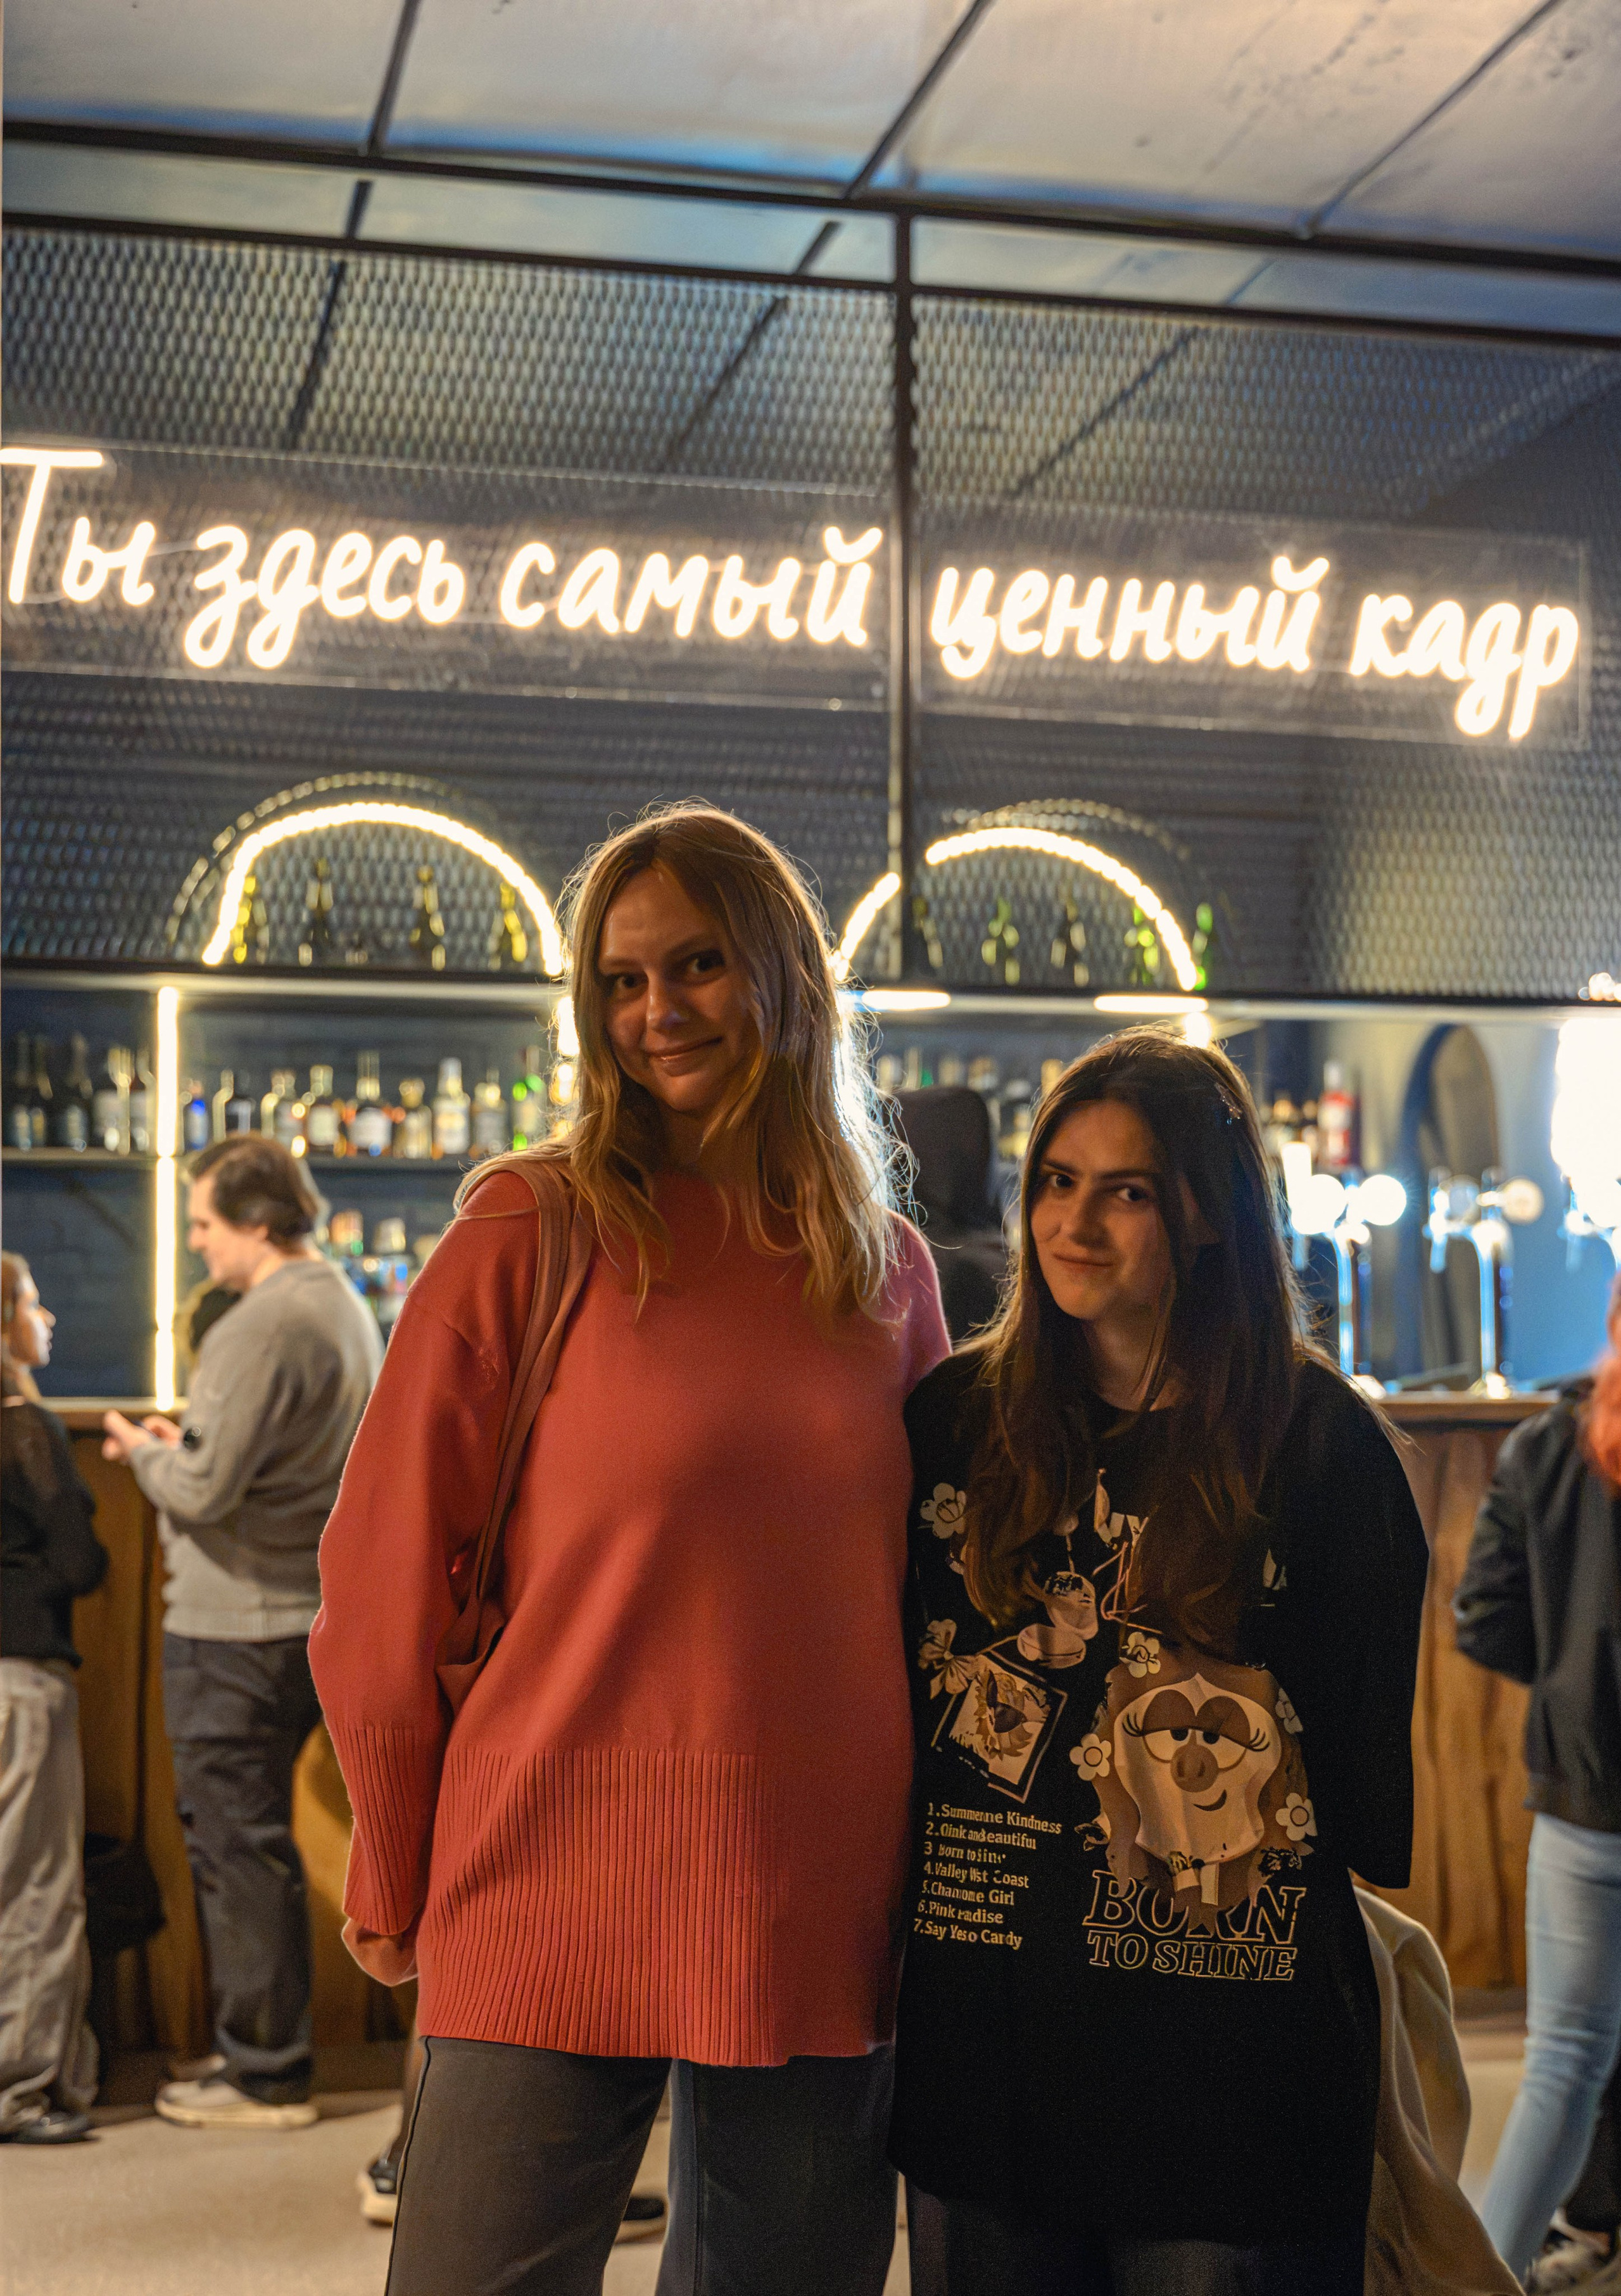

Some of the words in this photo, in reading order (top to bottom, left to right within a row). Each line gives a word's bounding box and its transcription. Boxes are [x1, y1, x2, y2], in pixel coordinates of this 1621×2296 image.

[1, 447, 156, 606] Ты
[184, 524, 465, 669] здесь
[500, 526, 883, 648] самый
[931, 555, 1330, 680] ценный
[1349, 593, 1580, 740] кадр
[1006, 1811, 1063, 1835] Kindness
[985, 1832, 1037, 1850] eautifu
[988, 1889, 1015, 1906] Girl
[1087, 1930, 1149, 1970] TO
[1152, 1940, 1297, 1981] SHINE
